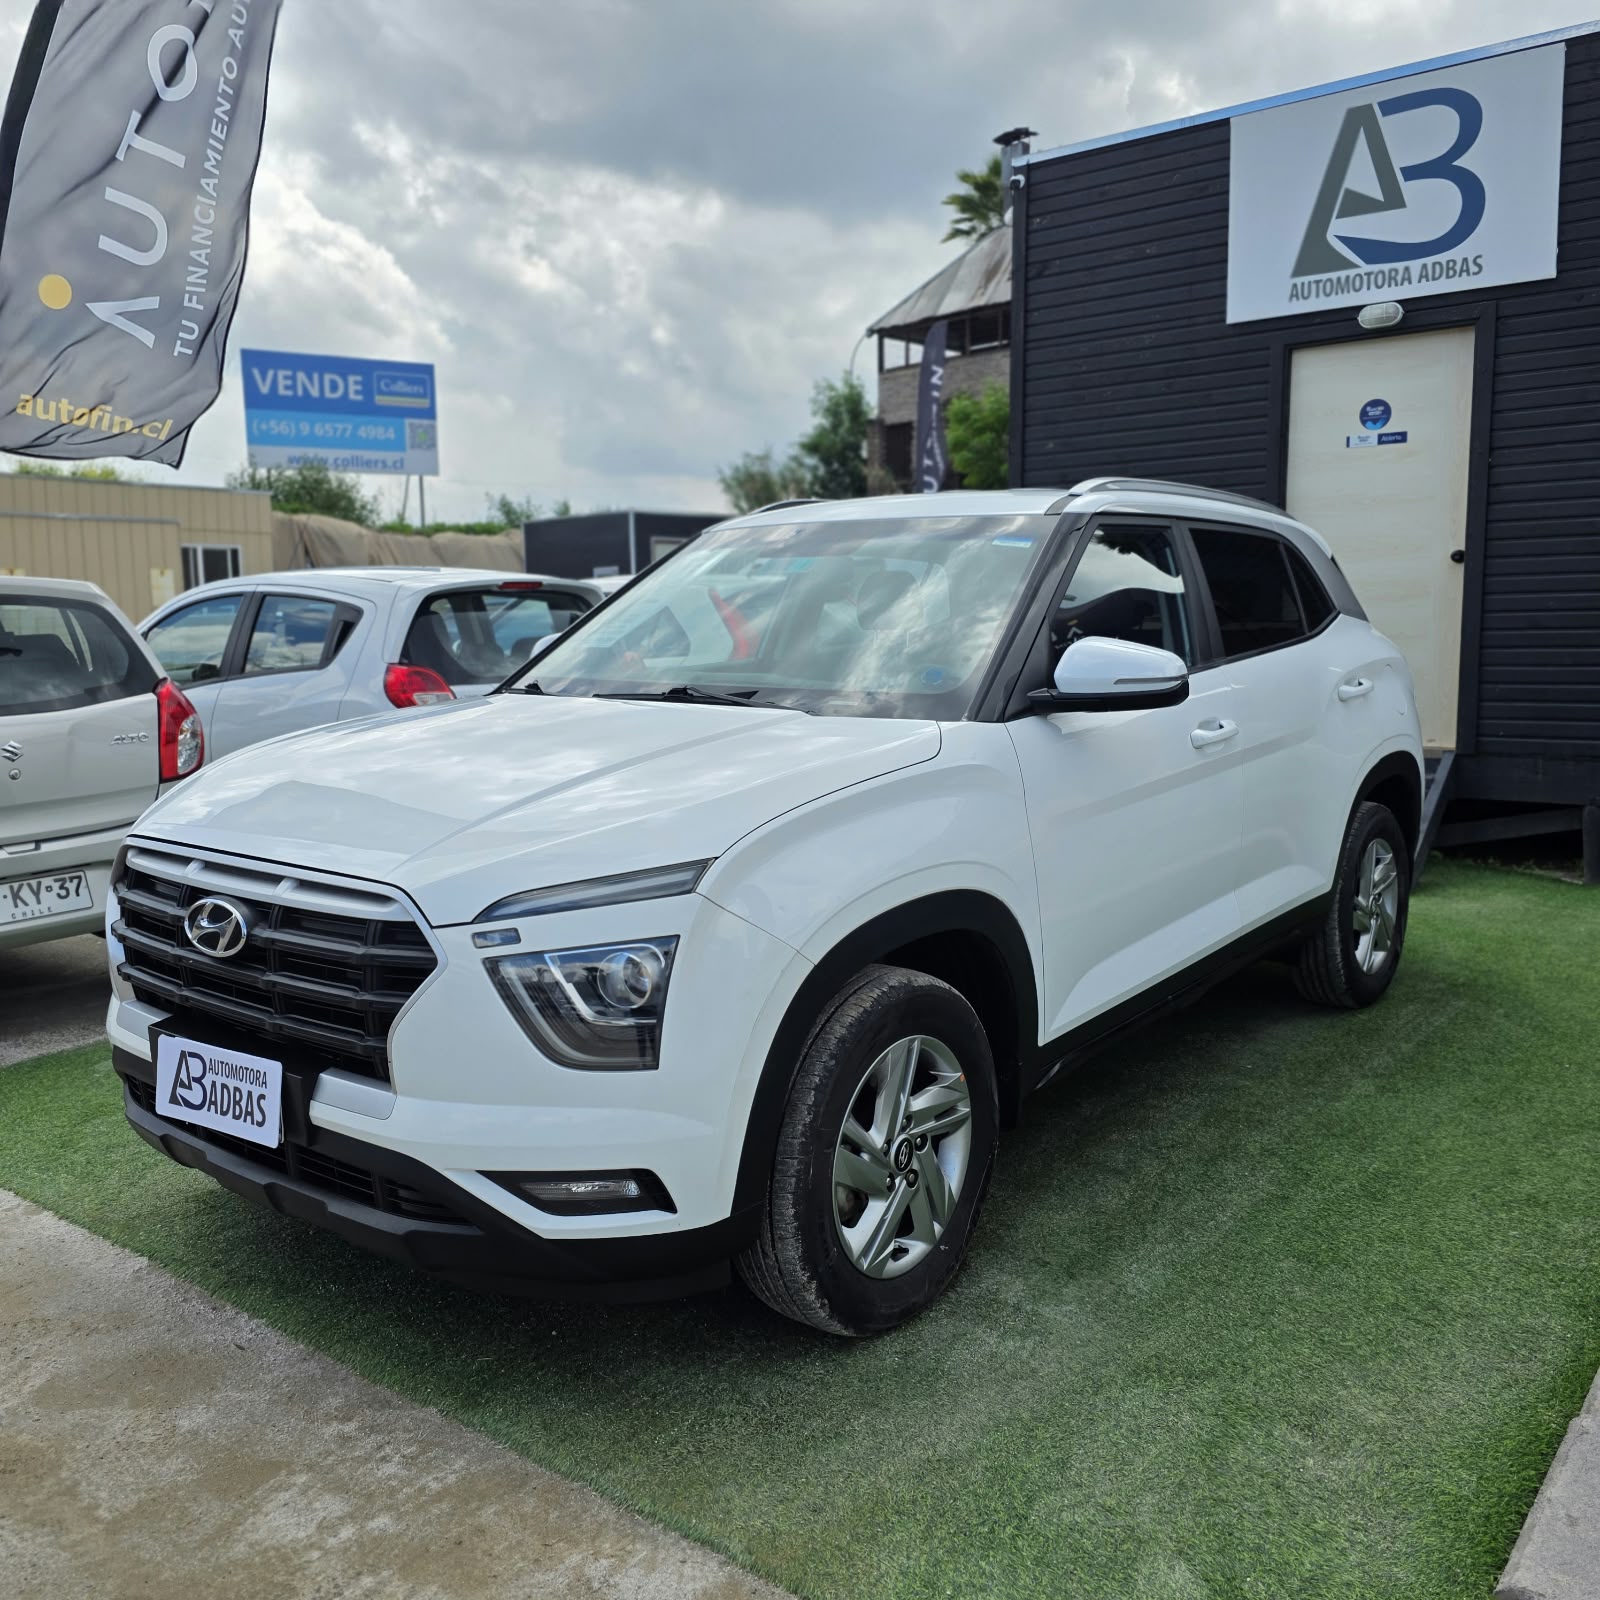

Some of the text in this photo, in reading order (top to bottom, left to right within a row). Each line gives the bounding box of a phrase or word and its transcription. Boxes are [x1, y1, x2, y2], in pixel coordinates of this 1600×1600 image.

[86, 0, 216, 349] AUTO
[172, 0, 251, 358] TU FINANCIAMIENTO AU
[1288, 254, 1484, 303] AUTOMOTORA ADBAS
[252, 367, 364, 401] VENDE
[379, 378, 425, 395] Colliers
[16, 394, 173, 441] autofin.cl
[252, 418, 396, 442] (+56) 9 6577 4984
[11, 906, 54, 920] CHILE
[208, 1057, 268, 1090] AUTOMOTORA
[206, 1080, 267, 1128] ADBAS
